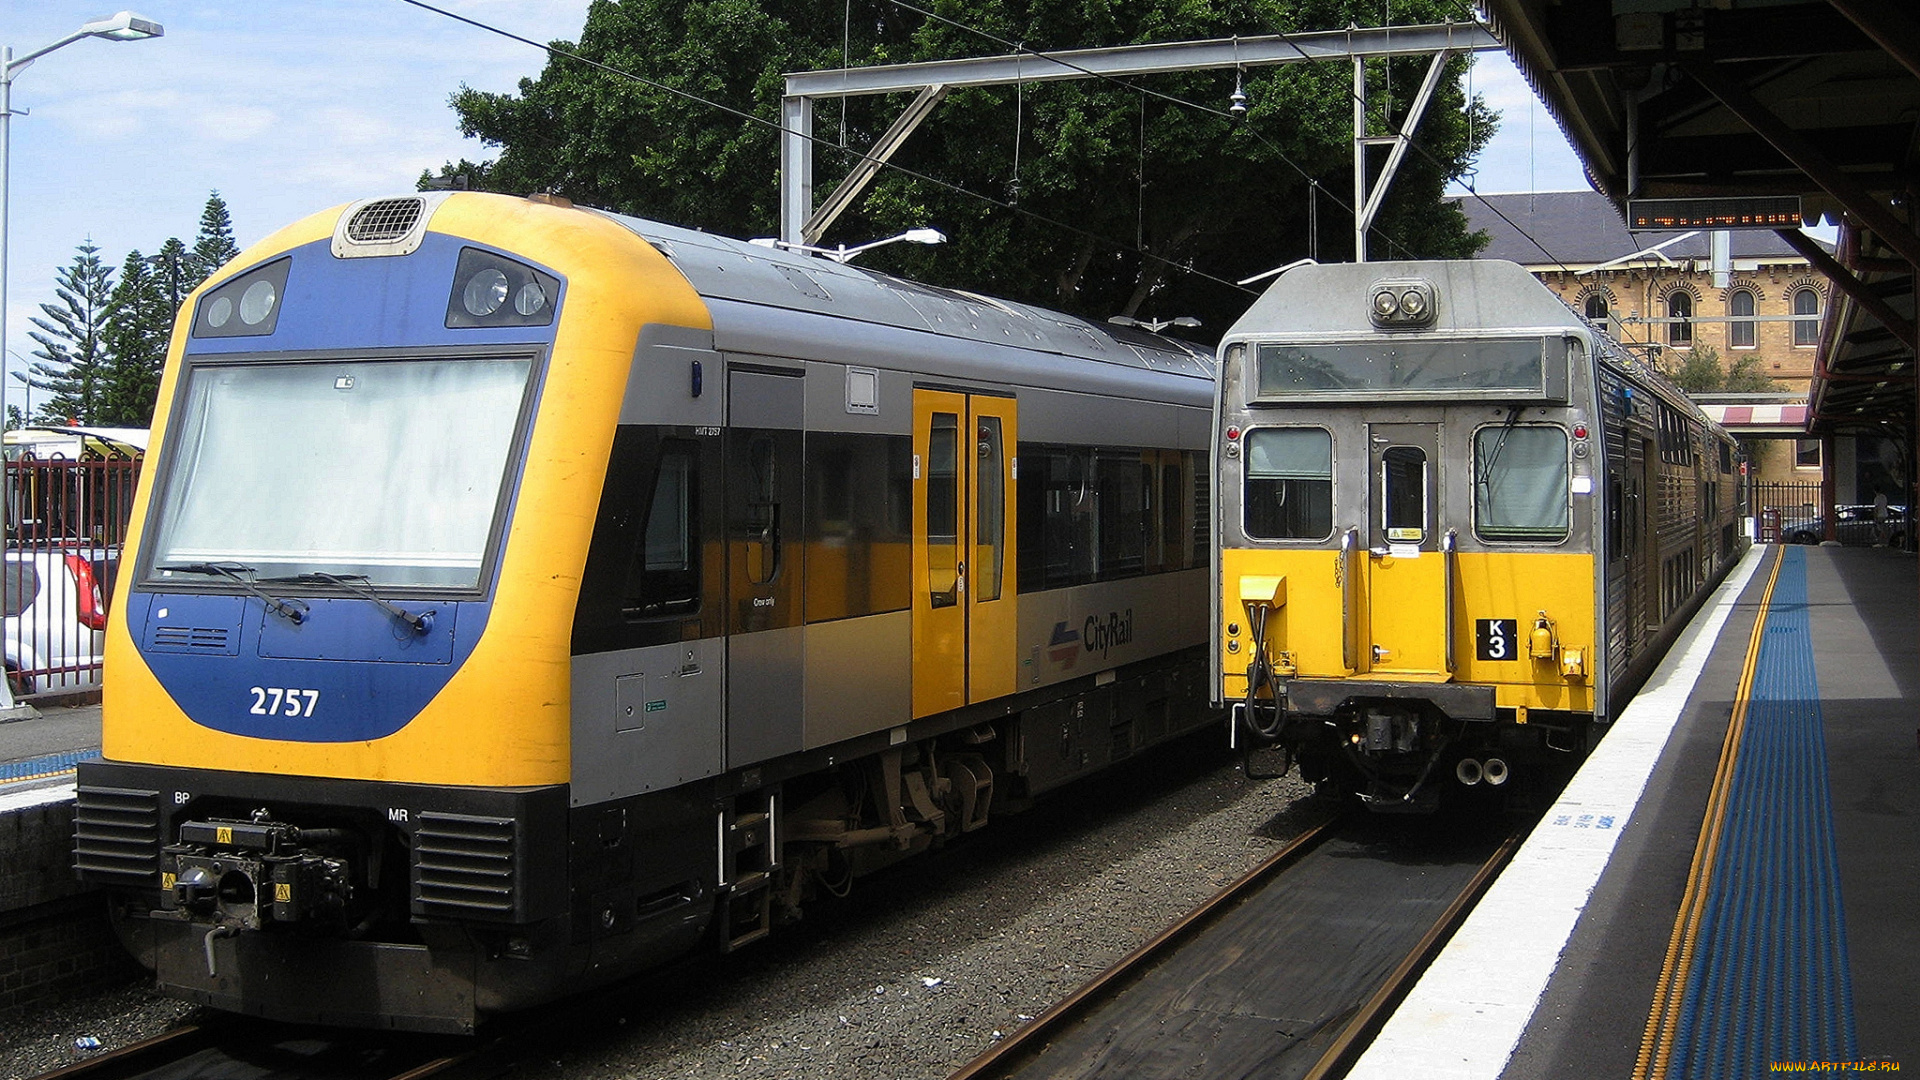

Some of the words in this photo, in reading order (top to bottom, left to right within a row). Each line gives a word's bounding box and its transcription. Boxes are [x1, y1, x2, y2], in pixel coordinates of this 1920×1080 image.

[708, 427, 721, 436] 2757
[1083, 608, 1133, 660] CityRail
[1489, 620, 1504, 636] K
[1488, 635, 1506, 659] 3
[249, 686, 320, 718] 2757
[174, 791, 191, 805] BP
[387, 807, 409, 822] MR
